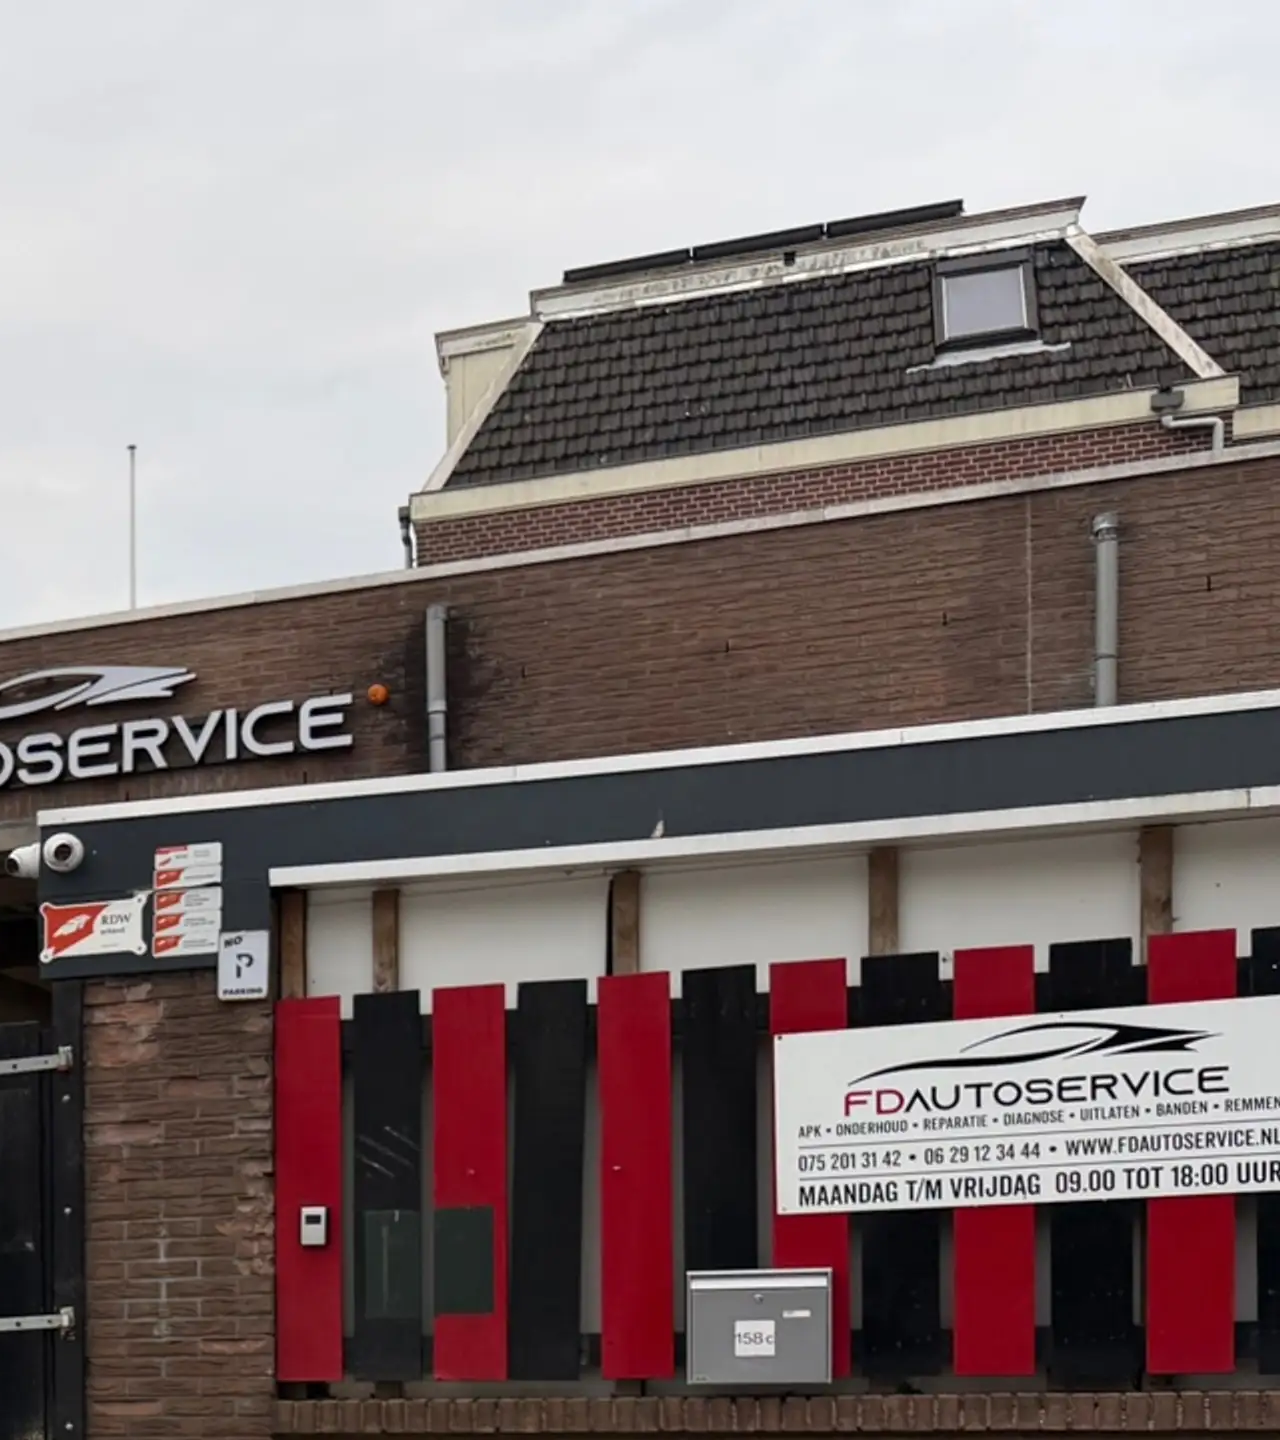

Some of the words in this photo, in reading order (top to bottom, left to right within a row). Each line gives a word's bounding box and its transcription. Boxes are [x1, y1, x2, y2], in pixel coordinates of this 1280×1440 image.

[101, 914, 131, 925] RDW
[844, 1066, 1229, 1116] FDAUTOSERVICE
[798, 1124, 822, 1138] APK
[836, 1120, 908, 1137] ONDERHOUD
[923, 1115, 988, 1131] REPARATIE
[1004, 1109, 1064, 1126] DIAGNOSE
[1080, 1105, 1140, 1121] UITLATEN
[1156, 1101, 1208, 1117] BANDEN
[798, 1154, 826, 1172] 075
[831, 1152, 856, 1170] 201
[862, 1151, 877, 1168] 31
[882, 1150, 901, 1167] 42
[924, 1148, 944, 1165] 06
[950, 1146, 969, 1163] 29
[975, 1145, 990, 1162] 12
[996, 1144, 1015, 1161] 34
[1021, 1142, 1040, 1159] 44
[1065, 1128, 1280, 1156] WWW.FDAUTOSERVICE.NL
[799, 1181, 898, 1207] MAANDAG
[906, 1177, 942, 1203] T/M
[950, 1173, 1040, 1199] VRIJDAG
[1055, 1169, 1115, 1194] 09.00
[1122, 1166, 1163, 1190] TOT
[1172, 1163, 1228, 1187] 18:00
[1237, 1160, 1280, 1184] UUR
